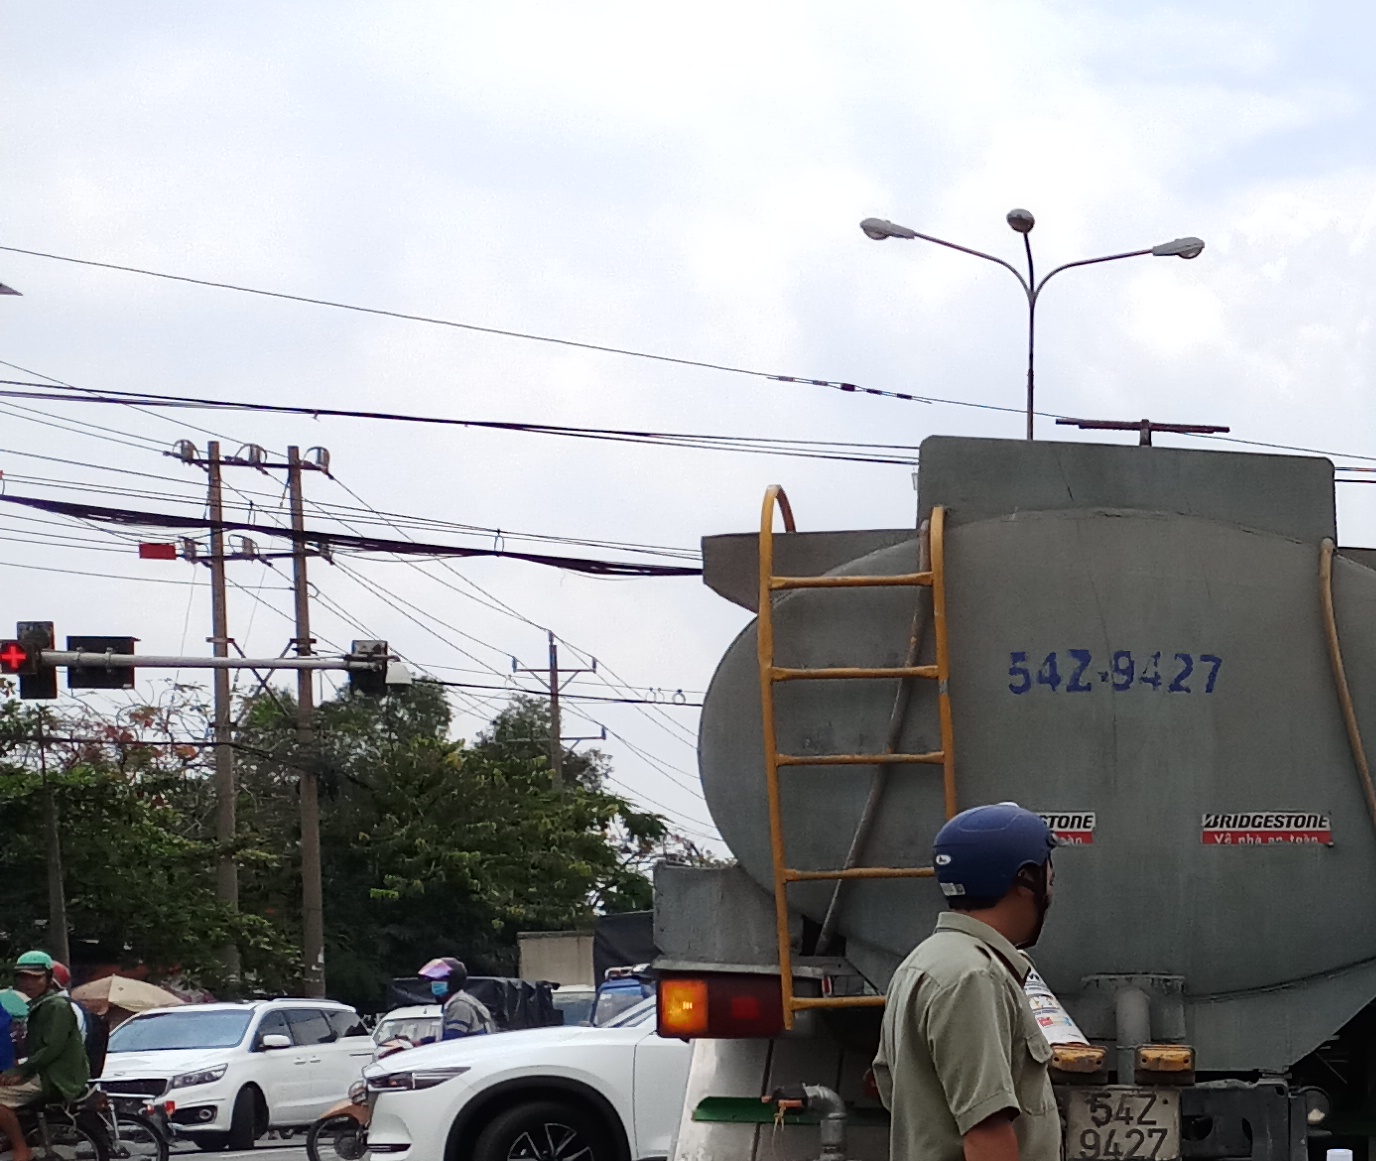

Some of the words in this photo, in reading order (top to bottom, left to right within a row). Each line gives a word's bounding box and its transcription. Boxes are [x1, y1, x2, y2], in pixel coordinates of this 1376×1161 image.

[1204, 813, 1329, 828] BRIDGESTONE
[1089, 1092, 1157, 1128] 54Z
[1079, 1127, 1168, 1161] 9427
